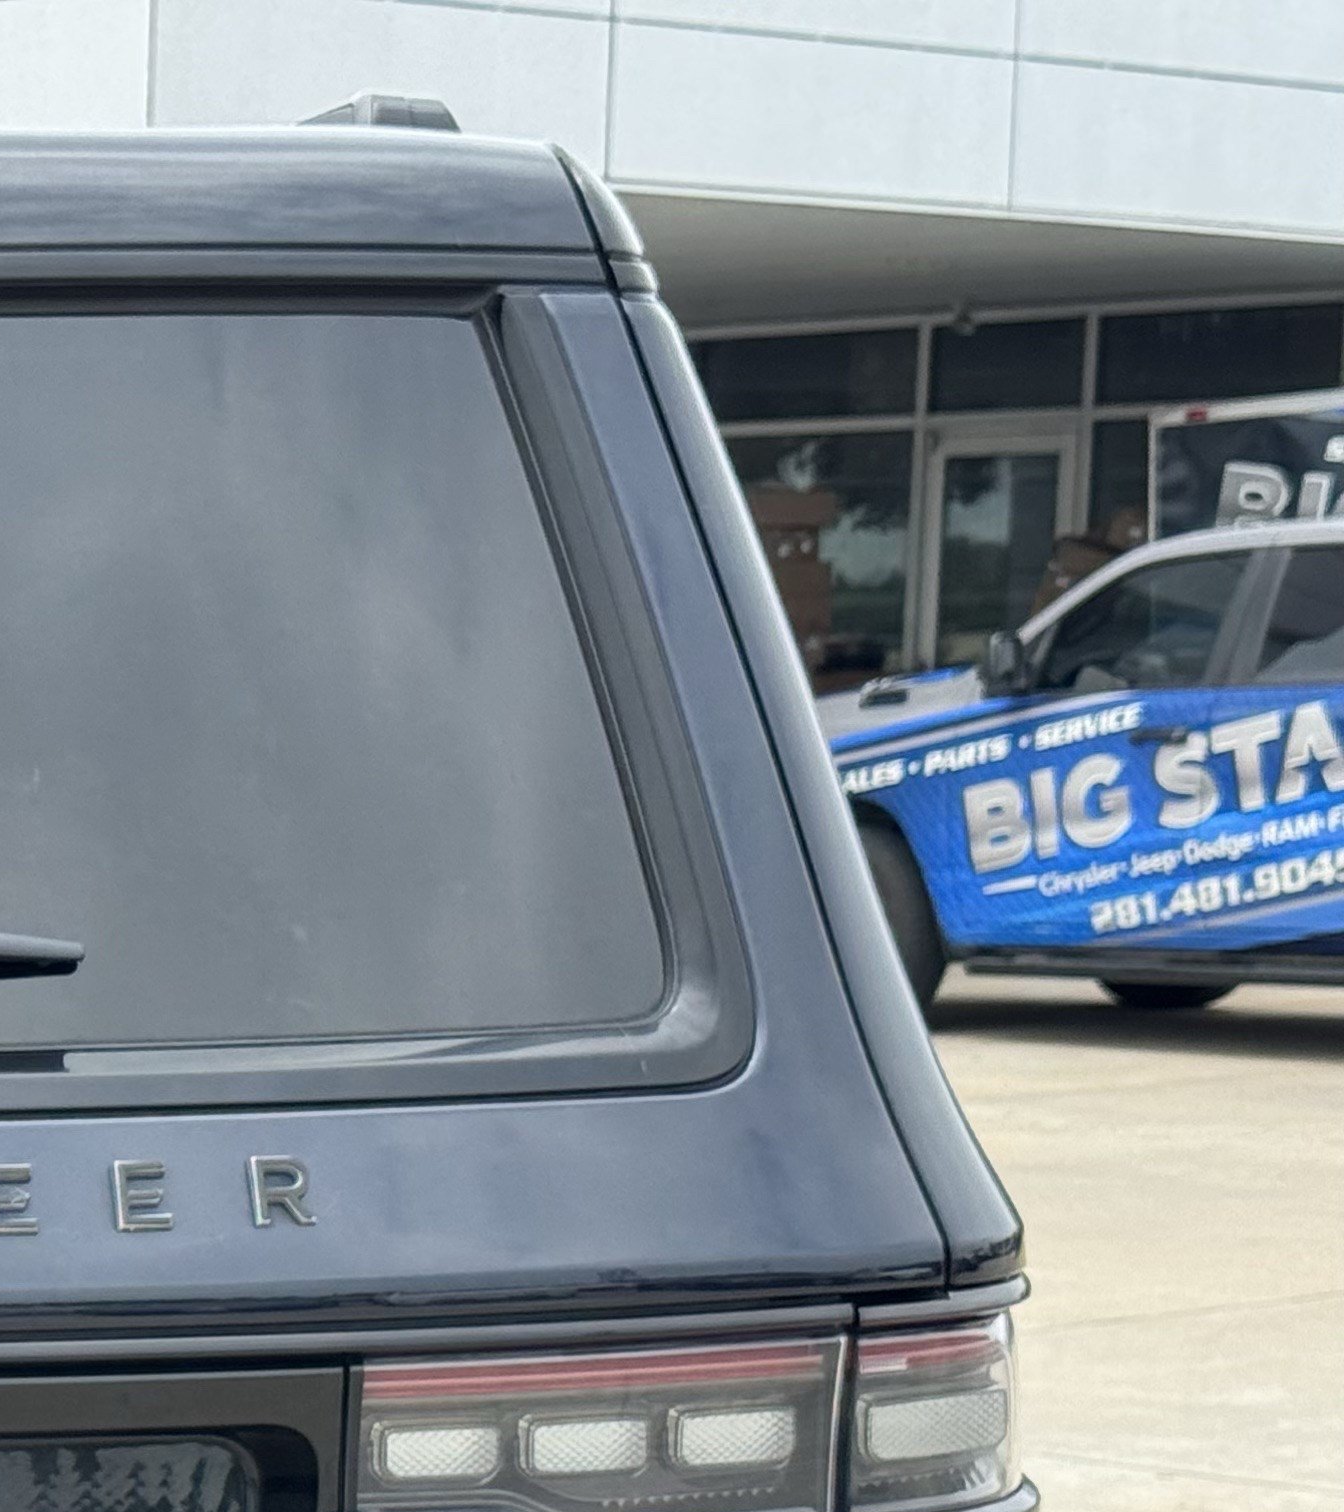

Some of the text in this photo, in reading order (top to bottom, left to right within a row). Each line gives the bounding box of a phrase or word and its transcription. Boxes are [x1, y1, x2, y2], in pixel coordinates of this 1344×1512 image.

[922, 733, 1013, 777] PARTS
[1032, 700, 1144, 750] SERVICE
[963, 752, 1135, 875] BIG
